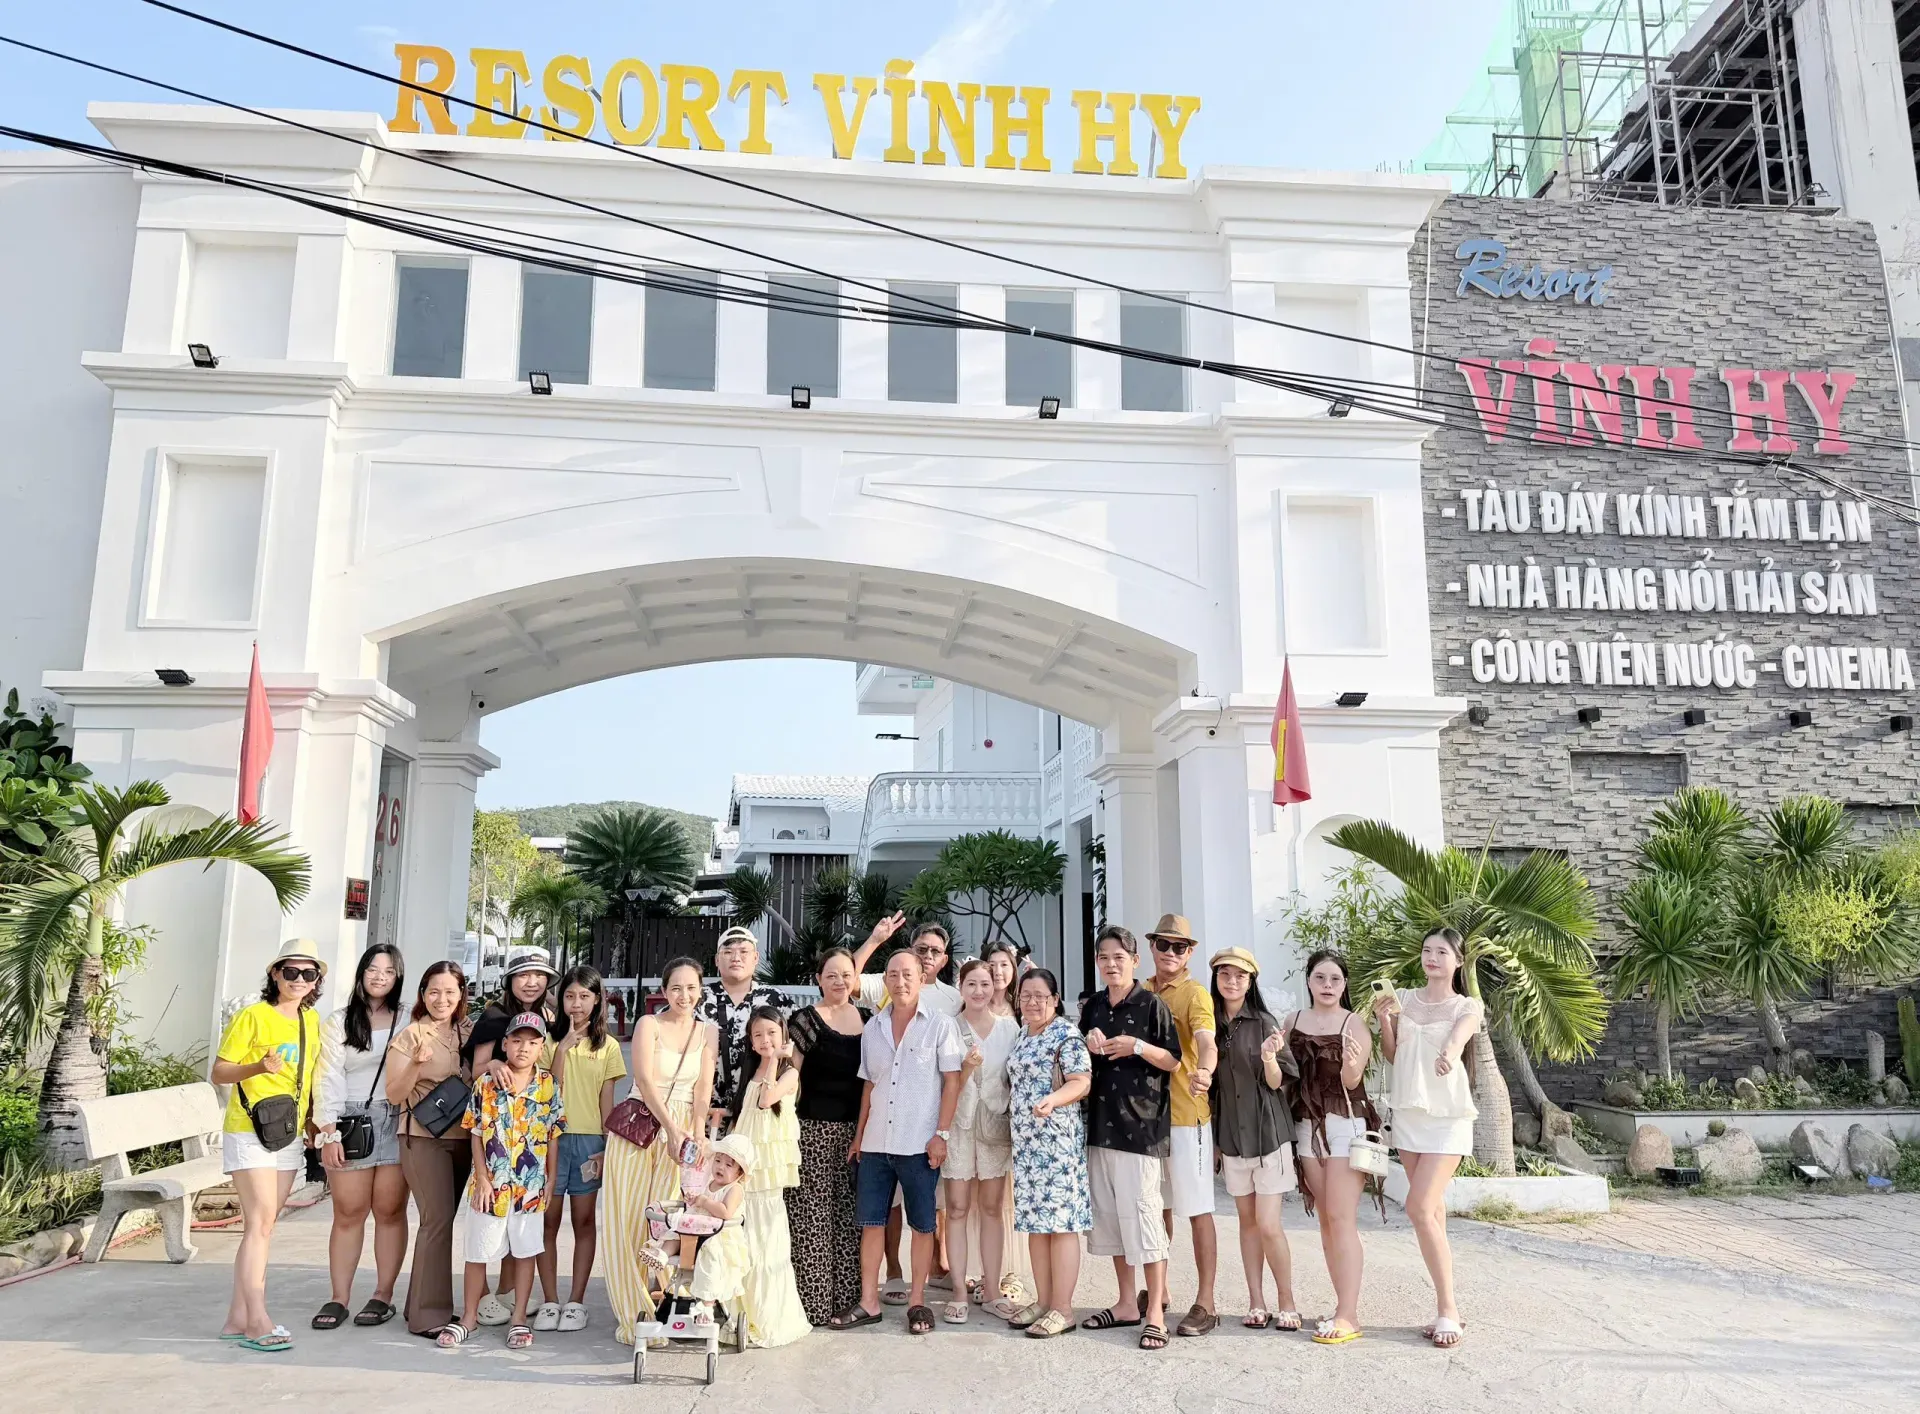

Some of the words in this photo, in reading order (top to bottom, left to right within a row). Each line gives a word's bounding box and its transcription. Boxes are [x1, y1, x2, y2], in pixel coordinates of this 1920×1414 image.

[387, 43, 789, 155] RESORT
[812, 58, 1051, 173] VĨNH
[1071, 89, 1201, 180] HY
[1454, 238, 1614, 307] Resort
[1454, 337, 1704, 452] VĨNH
[1719, 368, 1858, 455] HY
[1460, 480, 1531, 534] TÀU
[1539, 481, 1608, 535] ĐÁY
[1615, 485, 1707, 537] KÍNH
[1711, 479, 1792, 541] TẮM
[1794, 489, 1873, 550] LẶN
[1465, 556, 1550, 610] NHÀ
[1554, 557, 1658, 612] HÀNG
[1662, 547, 1729, 613] NỔI
[1732, 556, 1798, 614] HẢI
[1800, 559, 1878, 616] SẢN
[1469, 628, 1571, 685] CÔNG
[1575, 631, 1658, 687] VIÊN
[1663, 632, 1757, 689] NƯỚC
[1780, 644, 1916, 691] CINEMA
[375, 791, 401, 847] 26
